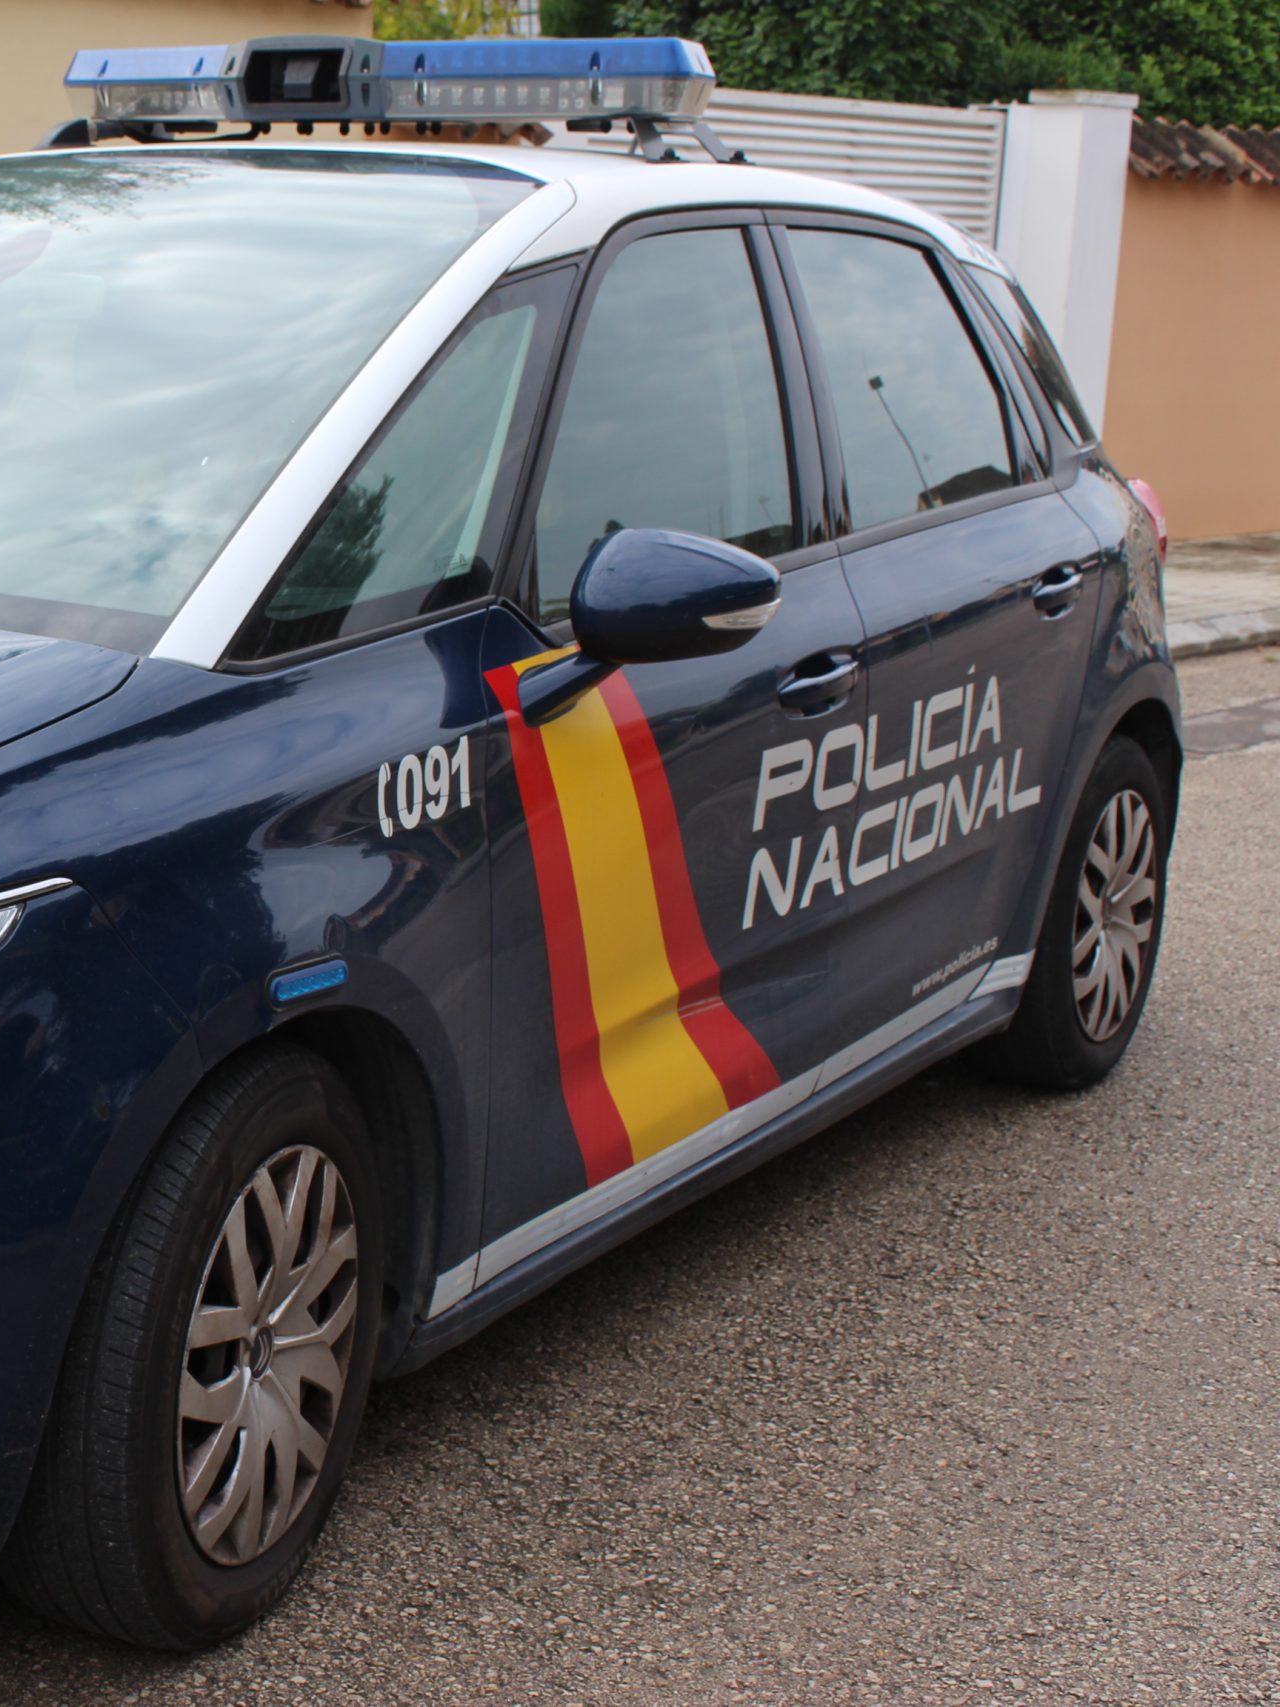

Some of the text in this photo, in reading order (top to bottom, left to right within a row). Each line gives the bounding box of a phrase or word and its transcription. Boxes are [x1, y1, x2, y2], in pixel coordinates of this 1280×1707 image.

[397, 735, 471, 829] 091
[752, 665, 1002, 832] POLICÍA
[742, 748, 1042, 930] NACIONAL
